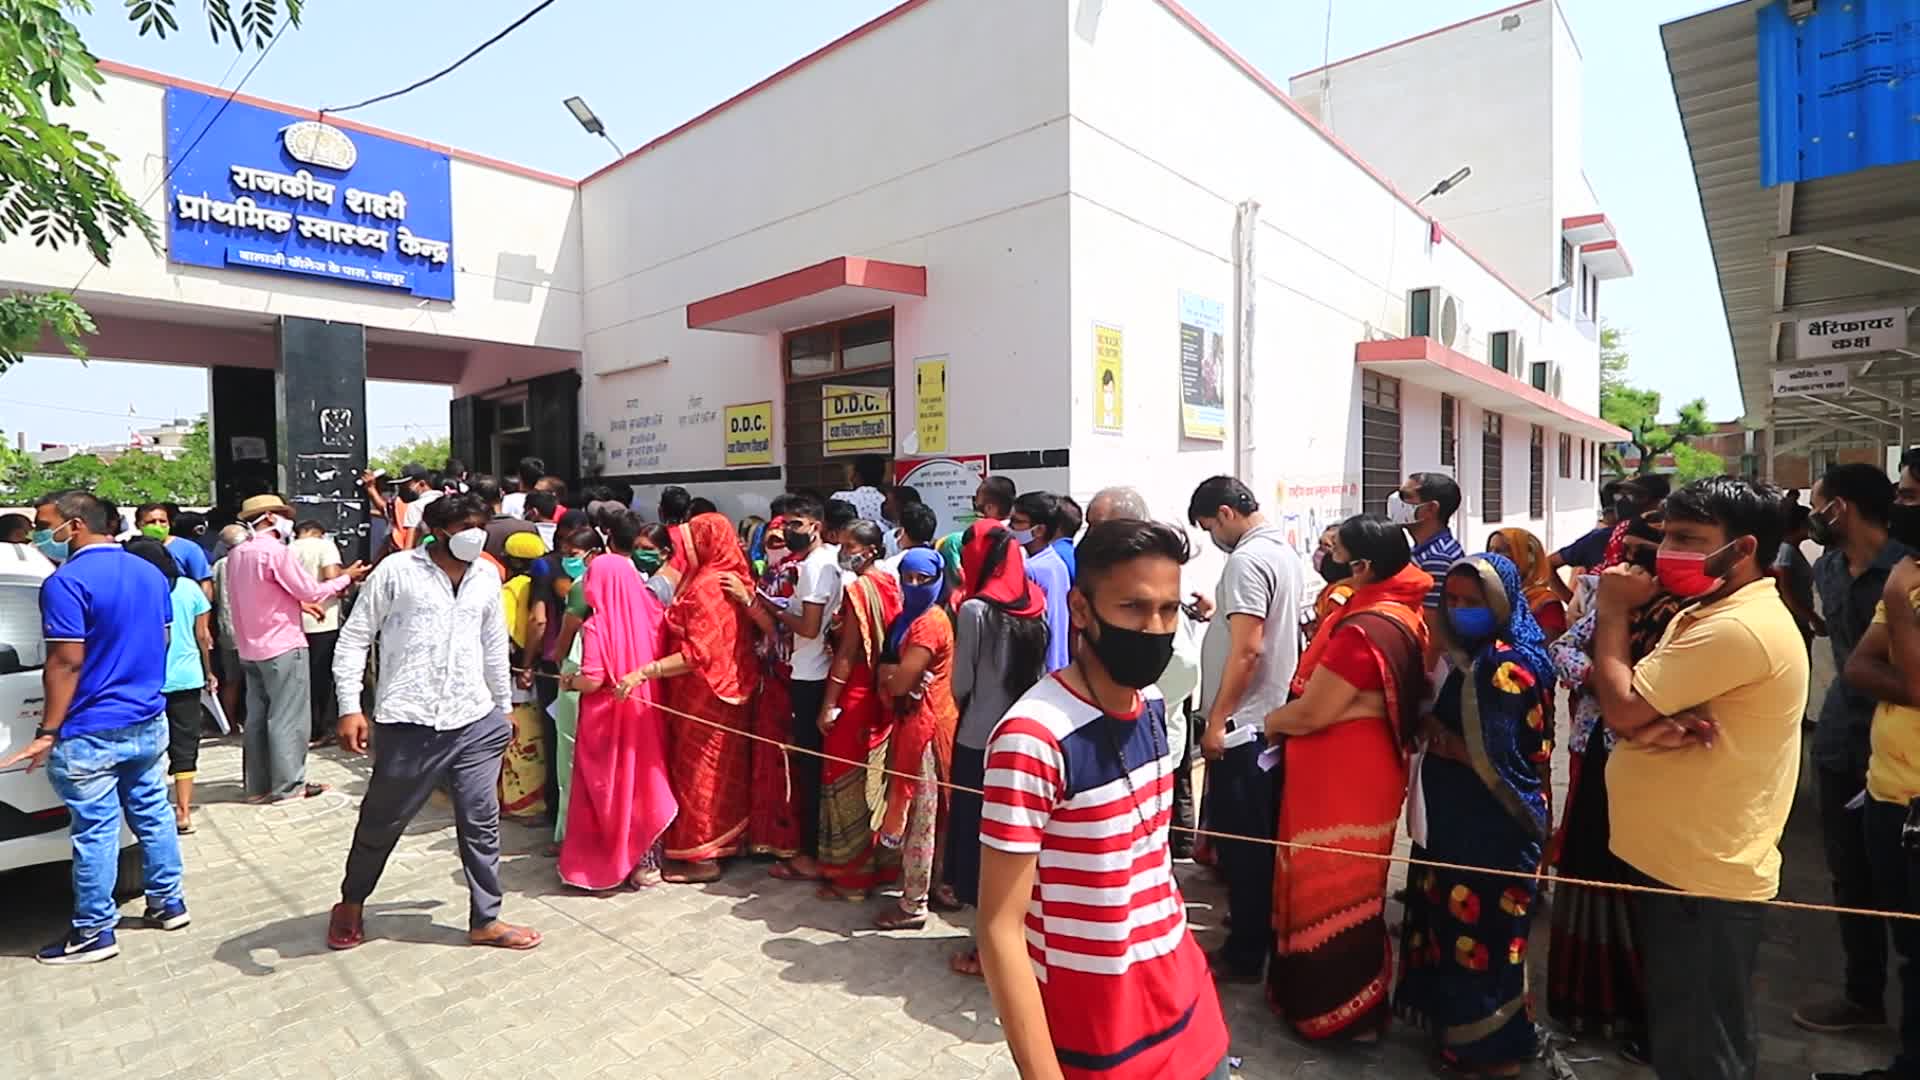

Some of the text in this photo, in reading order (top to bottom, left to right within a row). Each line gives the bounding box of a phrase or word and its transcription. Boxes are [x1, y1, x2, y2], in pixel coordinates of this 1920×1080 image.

[231, 165, 407, 220] राजकीय शहरी
[296, 214, 389, 252] स्वास्थ्य
[396, 226, 449, 264] केन्द्र
[239, 250, 285, 266] बालाजी
[327, 261, 341, 274] के
[834, 394, 880, 415] D.D.C.
[731, 414, 766, 433] D.D.C.
